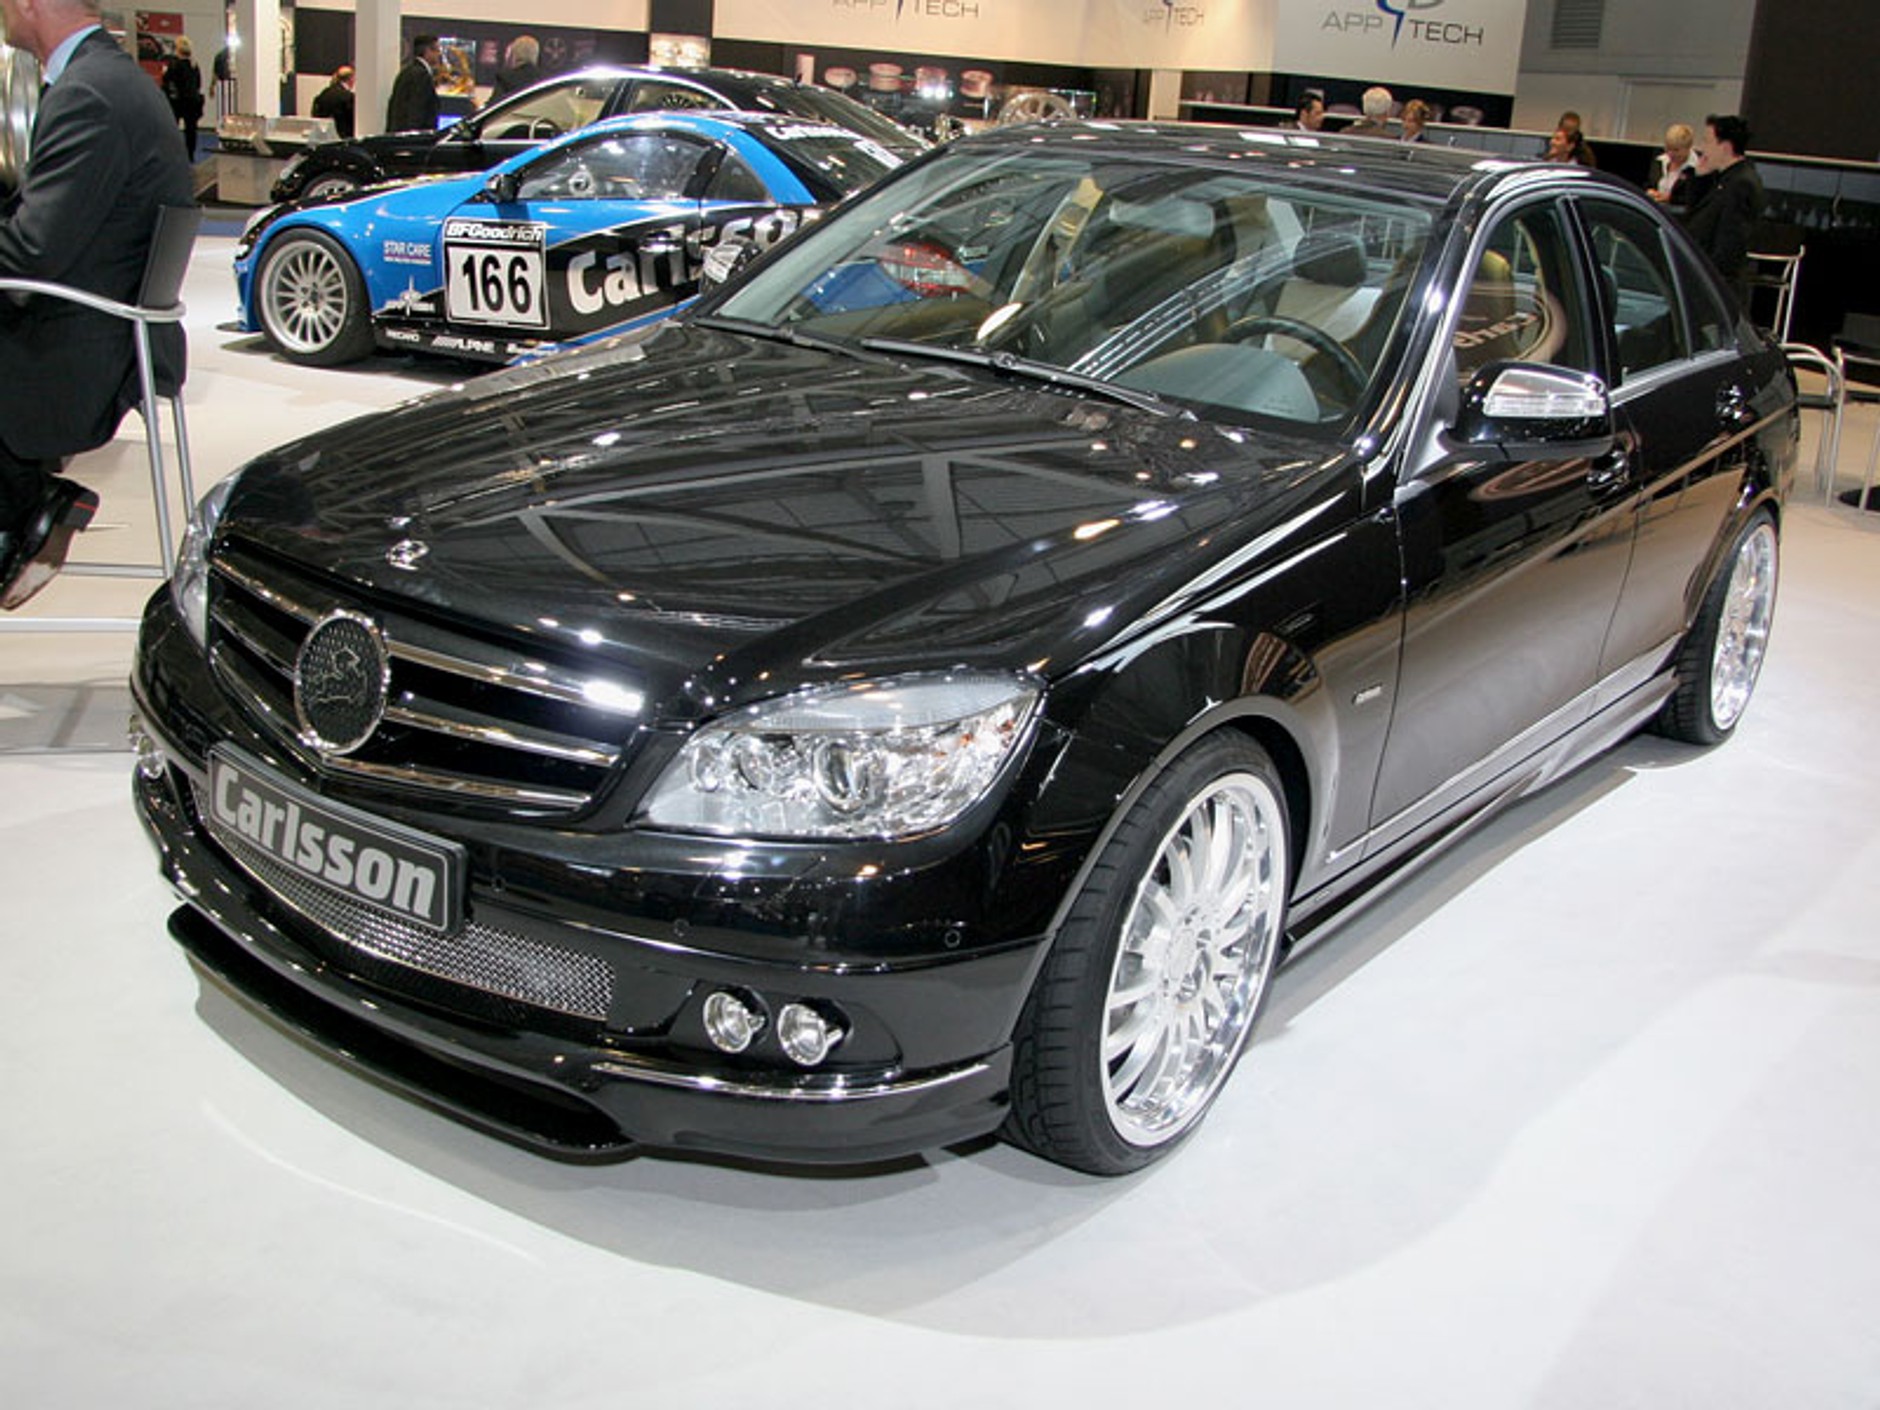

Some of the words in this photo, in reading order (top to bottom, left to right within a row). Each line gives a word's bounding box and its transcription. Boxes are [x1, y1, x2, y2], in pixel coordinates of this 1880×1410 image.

[914, 0, 979, 18] TECH
[1321, 11, 1383, 33] APP
[1408, 18, 1484, 46] TECH
[447, 223, 542, 241] BFGoodrich
[463, 254, 532, 314] 166
[215, 763, 437, 919] Carlsson
